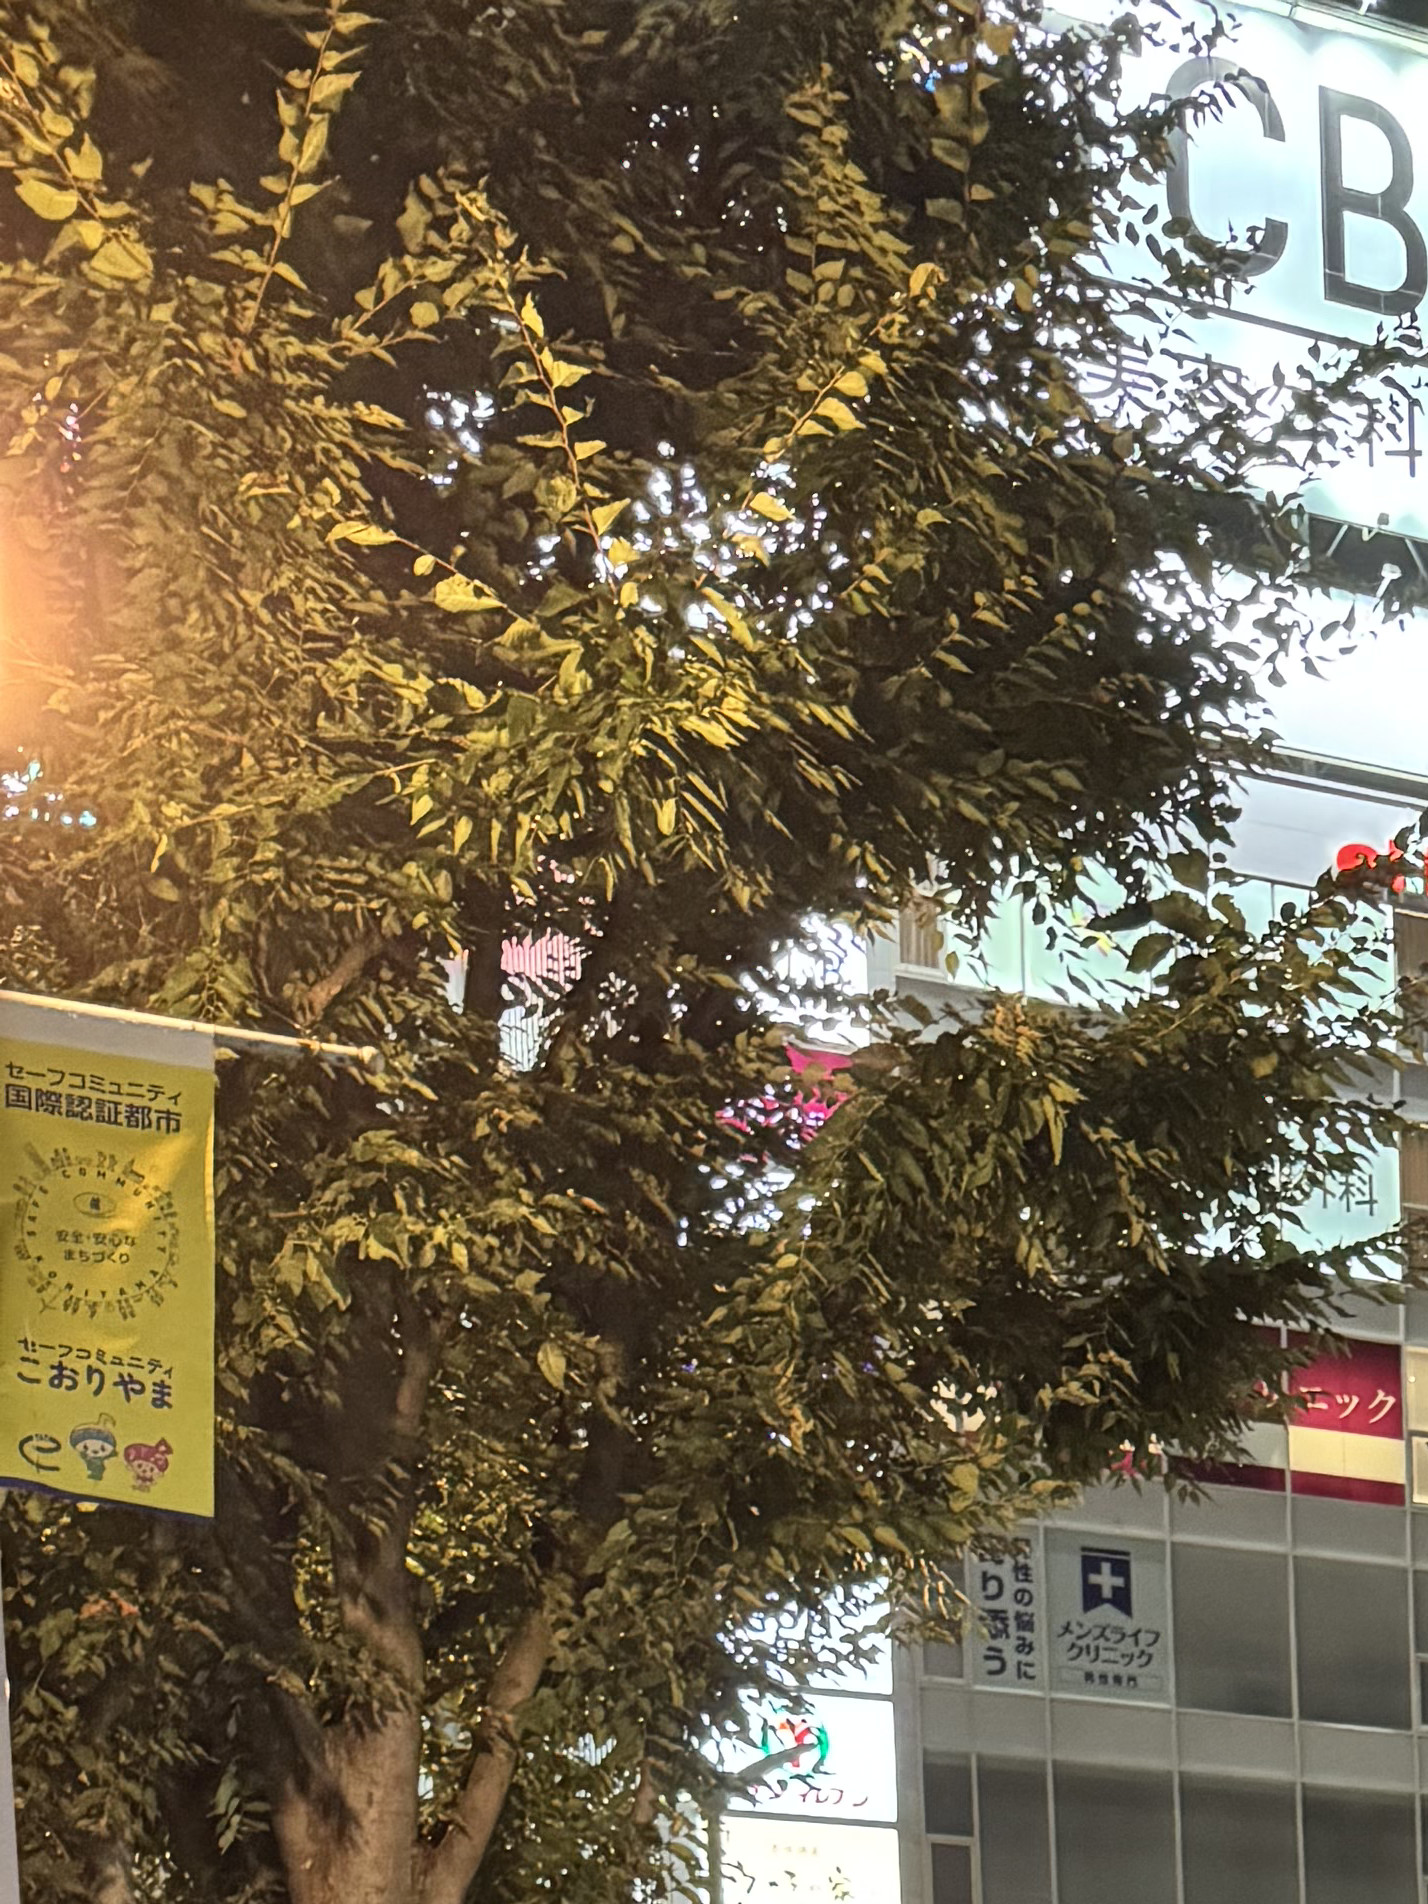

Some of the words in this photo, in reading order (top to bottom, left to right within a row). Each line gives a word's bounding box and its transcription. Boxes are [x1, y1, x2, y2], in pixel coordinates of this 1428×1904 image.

[5, 1061, 182, 1106] セーフコミュニティ
[5, 1083, 182, 1134] 国際認証都市
[17, 1337, 173, 1379] セーフコミュニティ
[17, 1356, 173, 1409] こおりやま
[978, 1537, 1010, 1676] り添う
[1057, 1621, 1161, 1648] メンズライフ
[1067, 1642, 1154, 1669] クリニック
